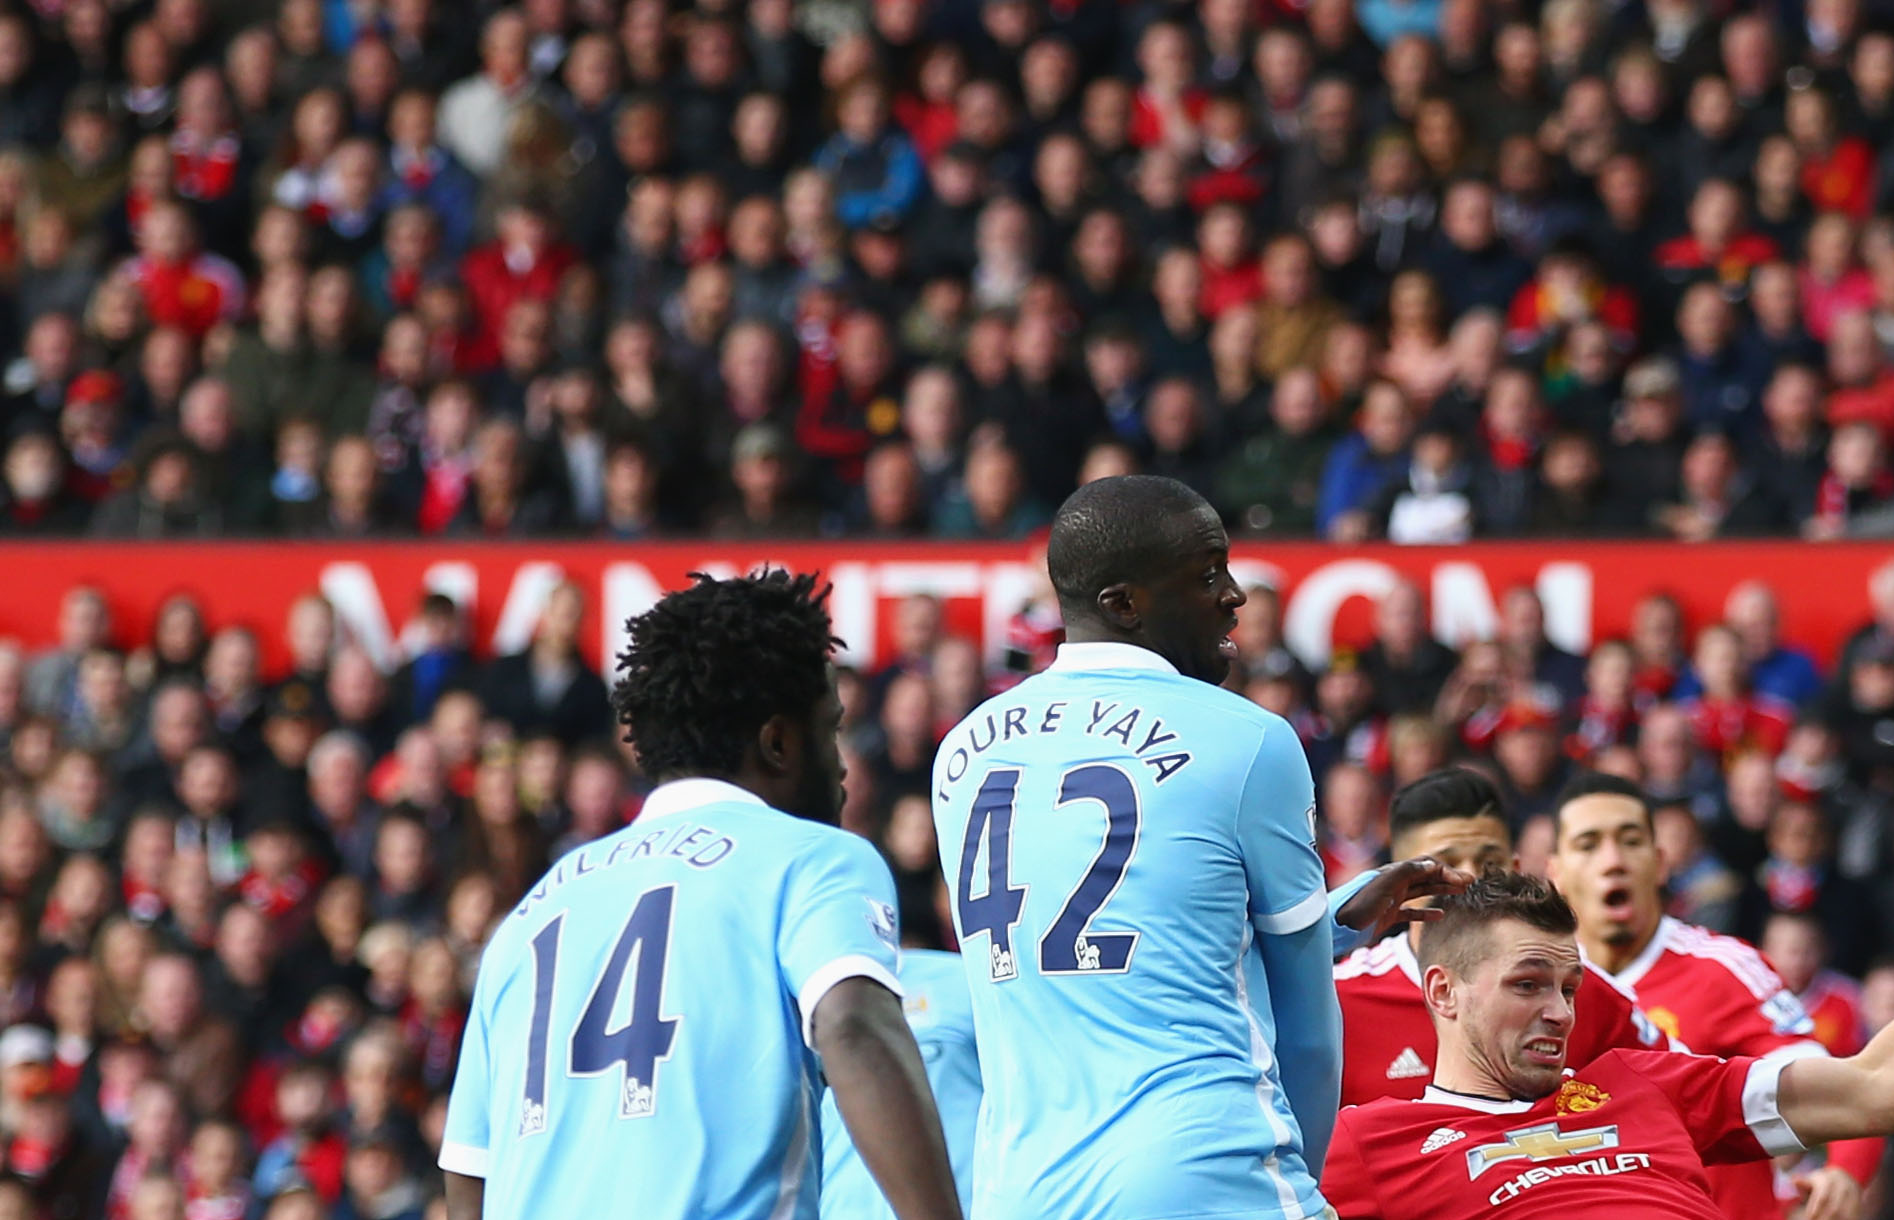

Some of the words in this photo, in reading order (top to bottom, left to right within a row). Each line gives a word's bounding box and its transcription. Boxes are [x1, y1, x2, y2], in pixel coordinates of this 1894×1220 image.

[939, 702, 1069, 802] TOURE
[1086, 700, 1191, 784] YAYA
[957, 761, 1143, 984] 42
[517, 882, 685, 1141] 14
[1488, 1152, 1651, 1206] CHEVROLET
